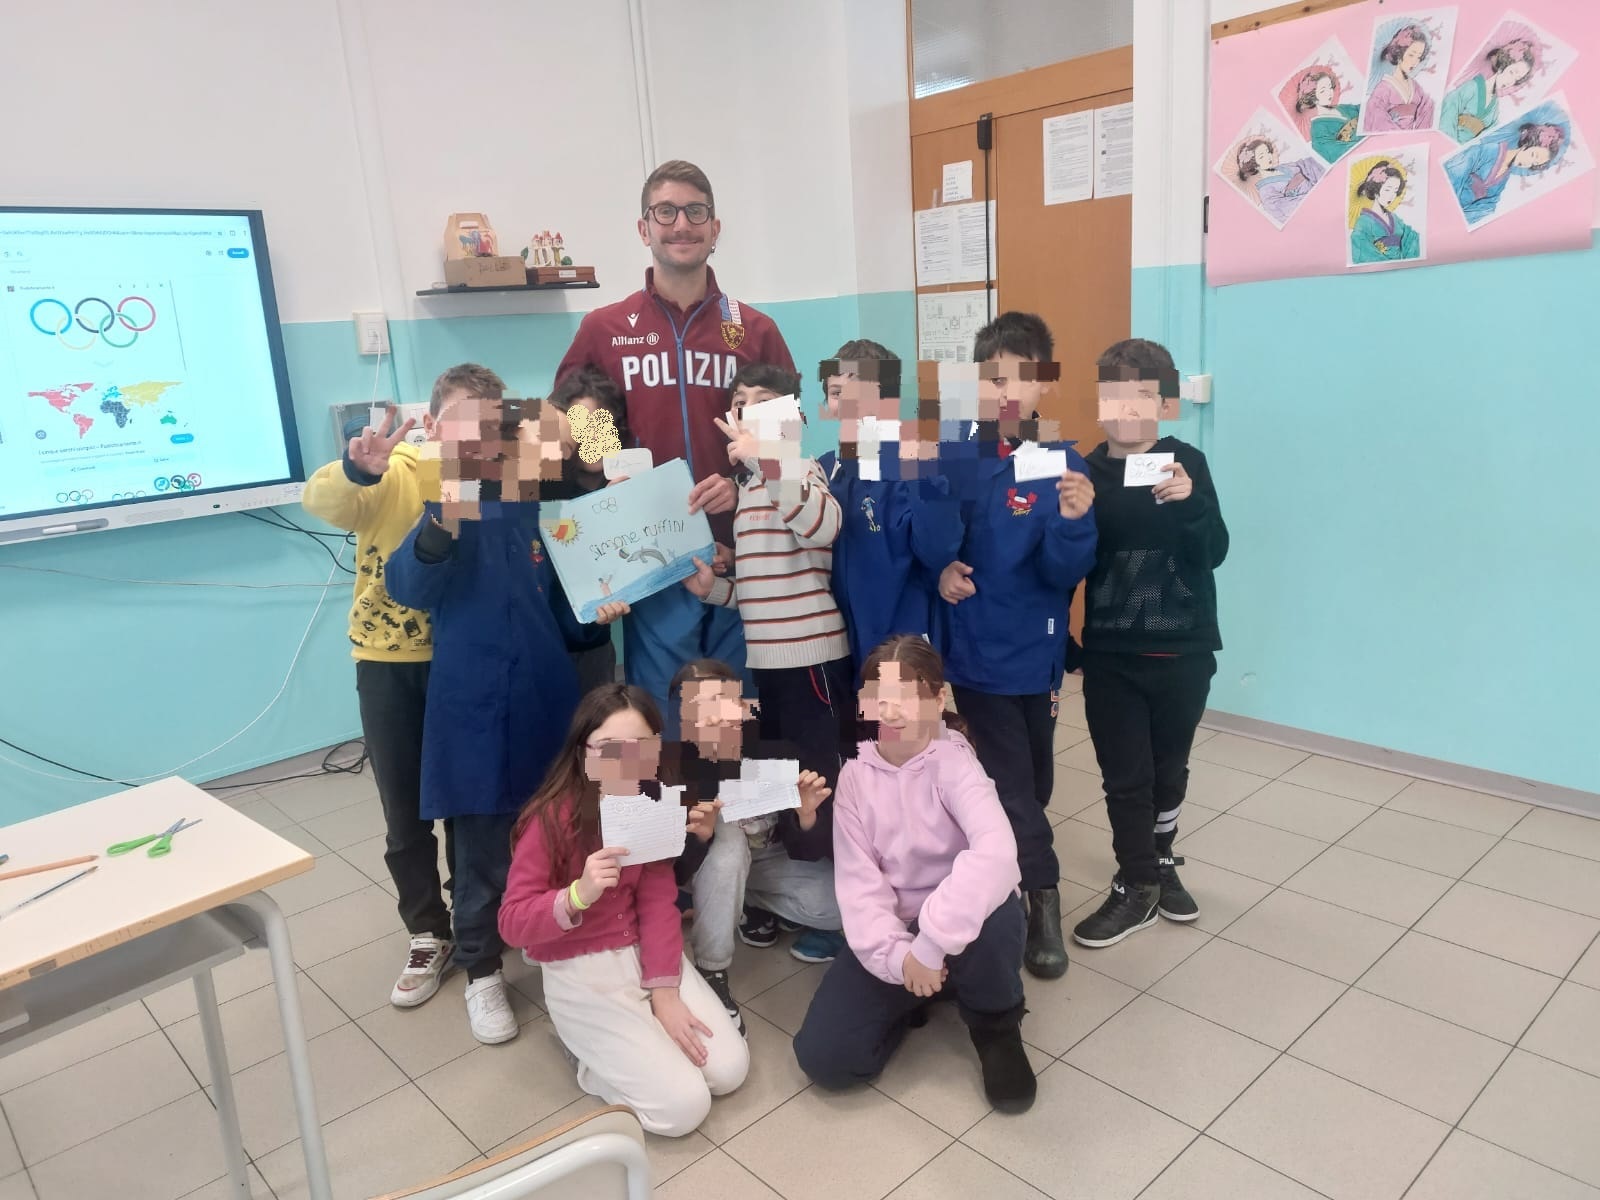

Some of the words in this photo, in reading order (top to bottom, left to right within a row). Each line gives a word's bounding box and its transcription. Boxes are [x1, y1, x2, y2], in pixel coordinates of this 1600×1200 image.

[612, 336, 645, 347] Allianz
[622, 350, 737, 391] POLIZIA
[1159, 857, 1174, 865] FILA
